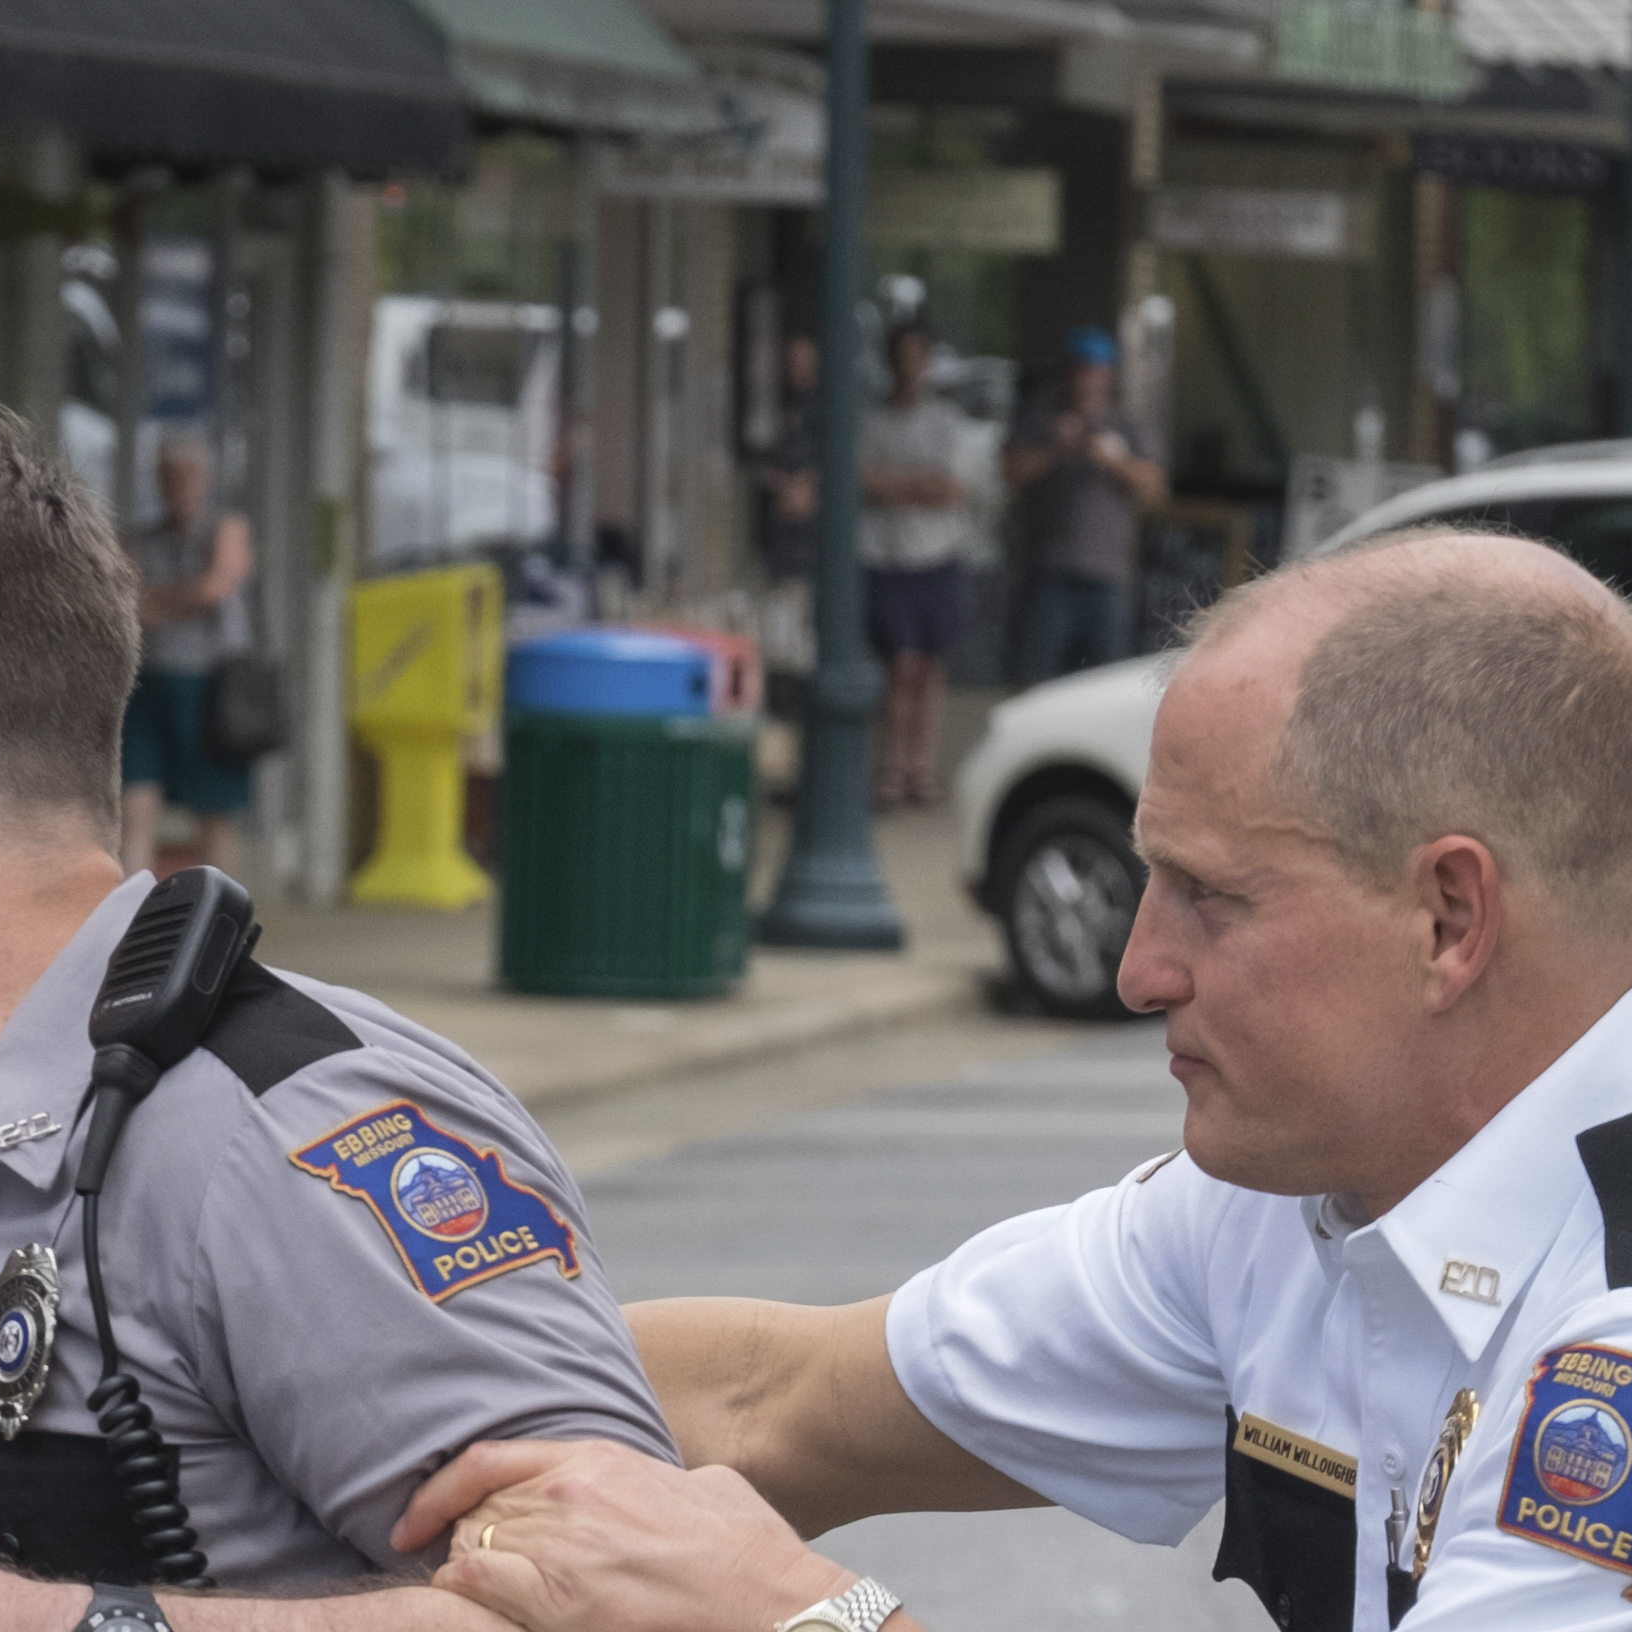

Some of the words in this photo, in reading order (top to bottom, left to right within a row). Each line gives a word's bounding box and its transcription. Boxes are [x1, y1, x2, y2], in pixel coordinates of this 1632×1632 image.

[332, 1113, 413, 1161] EBBING
[353, 1132, 415, 1168] MISSOURI
[432, 1225, 539, 1281] POLICE
[1553, 1371, 1617, 1398] MISSOURI
[1243, 1424, 1292, 1459] WILLIAM
